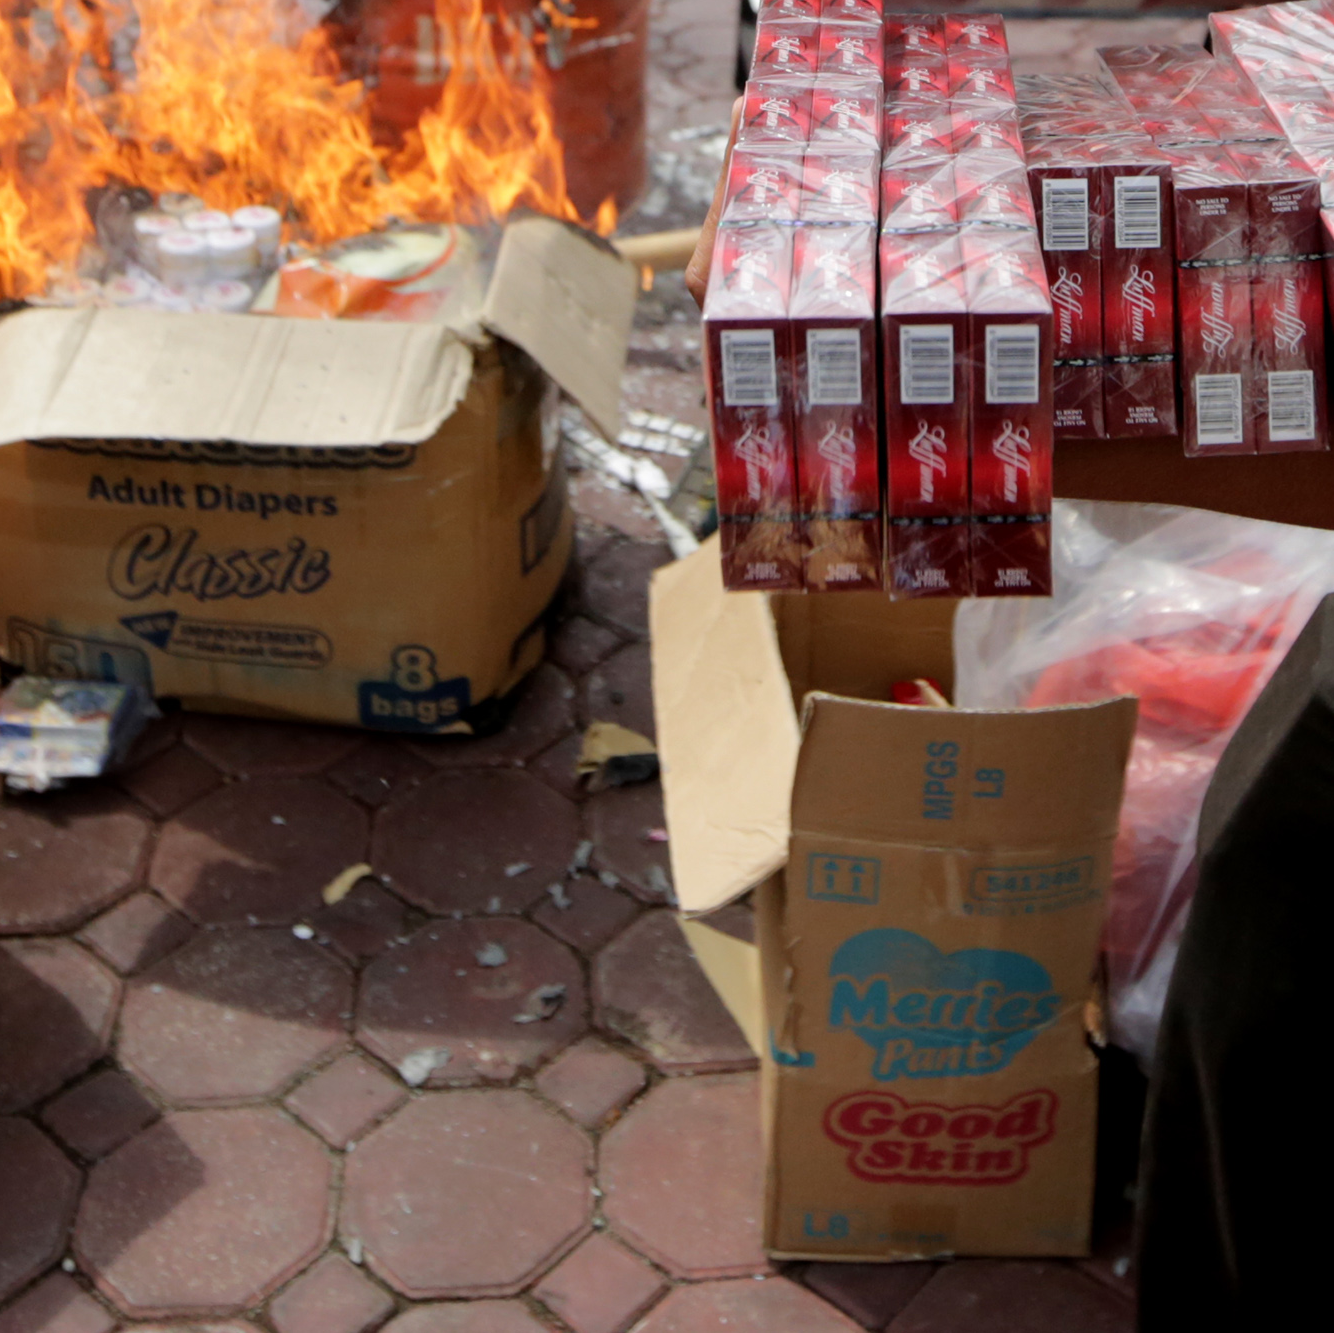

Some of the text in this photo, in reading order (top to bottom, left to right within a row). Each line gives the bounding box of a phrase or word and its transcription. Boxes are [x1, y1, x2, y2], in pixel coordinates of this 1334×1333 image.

[1051, 266, 1084, 344] Luffman
[1123, 264, 1156, 342] Luffman
[1201, 281, 1234, 358] Luffman
[1273, 278, 1306, 355] Luffman
[87, 475, 339, 519] Adult Diapers
[735, 422, 772, 501] Luffman
[818, 419, 856, 500] Luffman
[909, 418, 947, 502] Luffman
[993, 419, 1032, 502] Luffman
[107, 523, 332, 602] Classic
[371, 689, 459, 724] bags
[391, 644, 436, 693] 8
[922, 741, 959, 820] MPGS
[971, 768, 1006, 799] L8
[828, 978, 1062, 1029] Merries
[878, 1038, 1006, 1075] Pants
[838, 1097, 1045, 1140] Good
[864, 1140, 1014, 1171] Skin
[803, 1213, 850, 1239] L8
